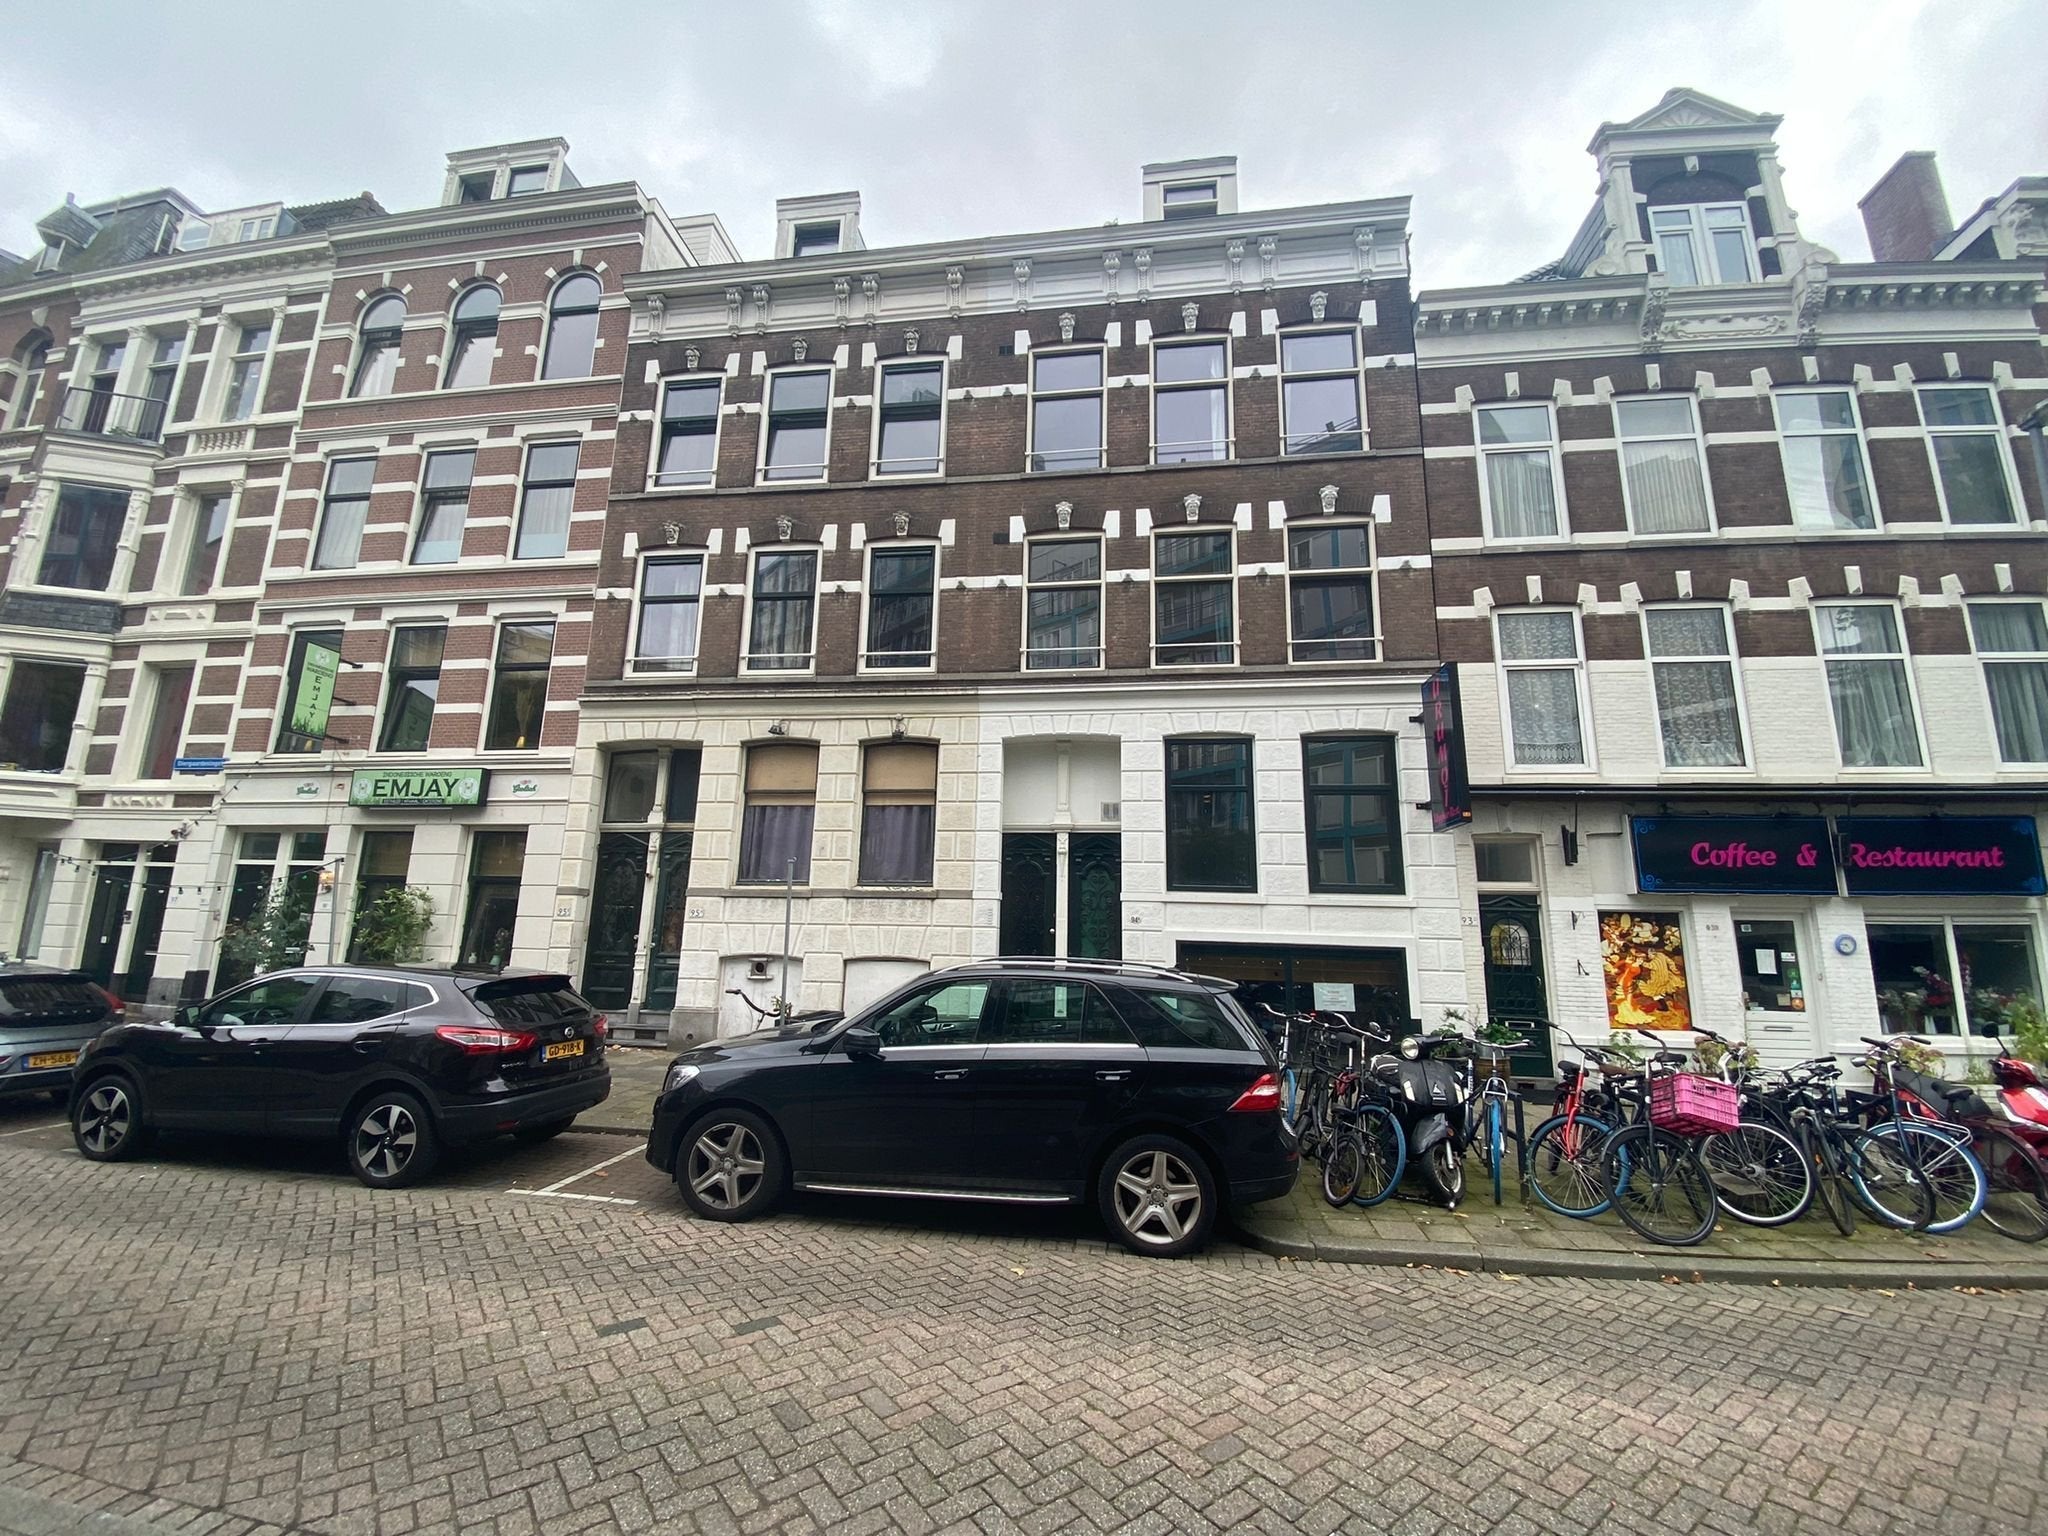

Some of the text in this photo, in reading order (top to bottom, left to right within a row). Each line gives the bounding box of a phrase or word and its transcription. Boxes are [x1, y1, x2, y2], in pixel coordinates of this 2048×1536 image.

[309, 675, 322, 718] EMJAY
[372, 778, 460, 797] EMJAY
[1690, 842, 2005, 868] Coffee & Restaurant
[548, 1042, 581, 1057] GD-918-K
[32, 1053, 76, 1066] ZH-568-
